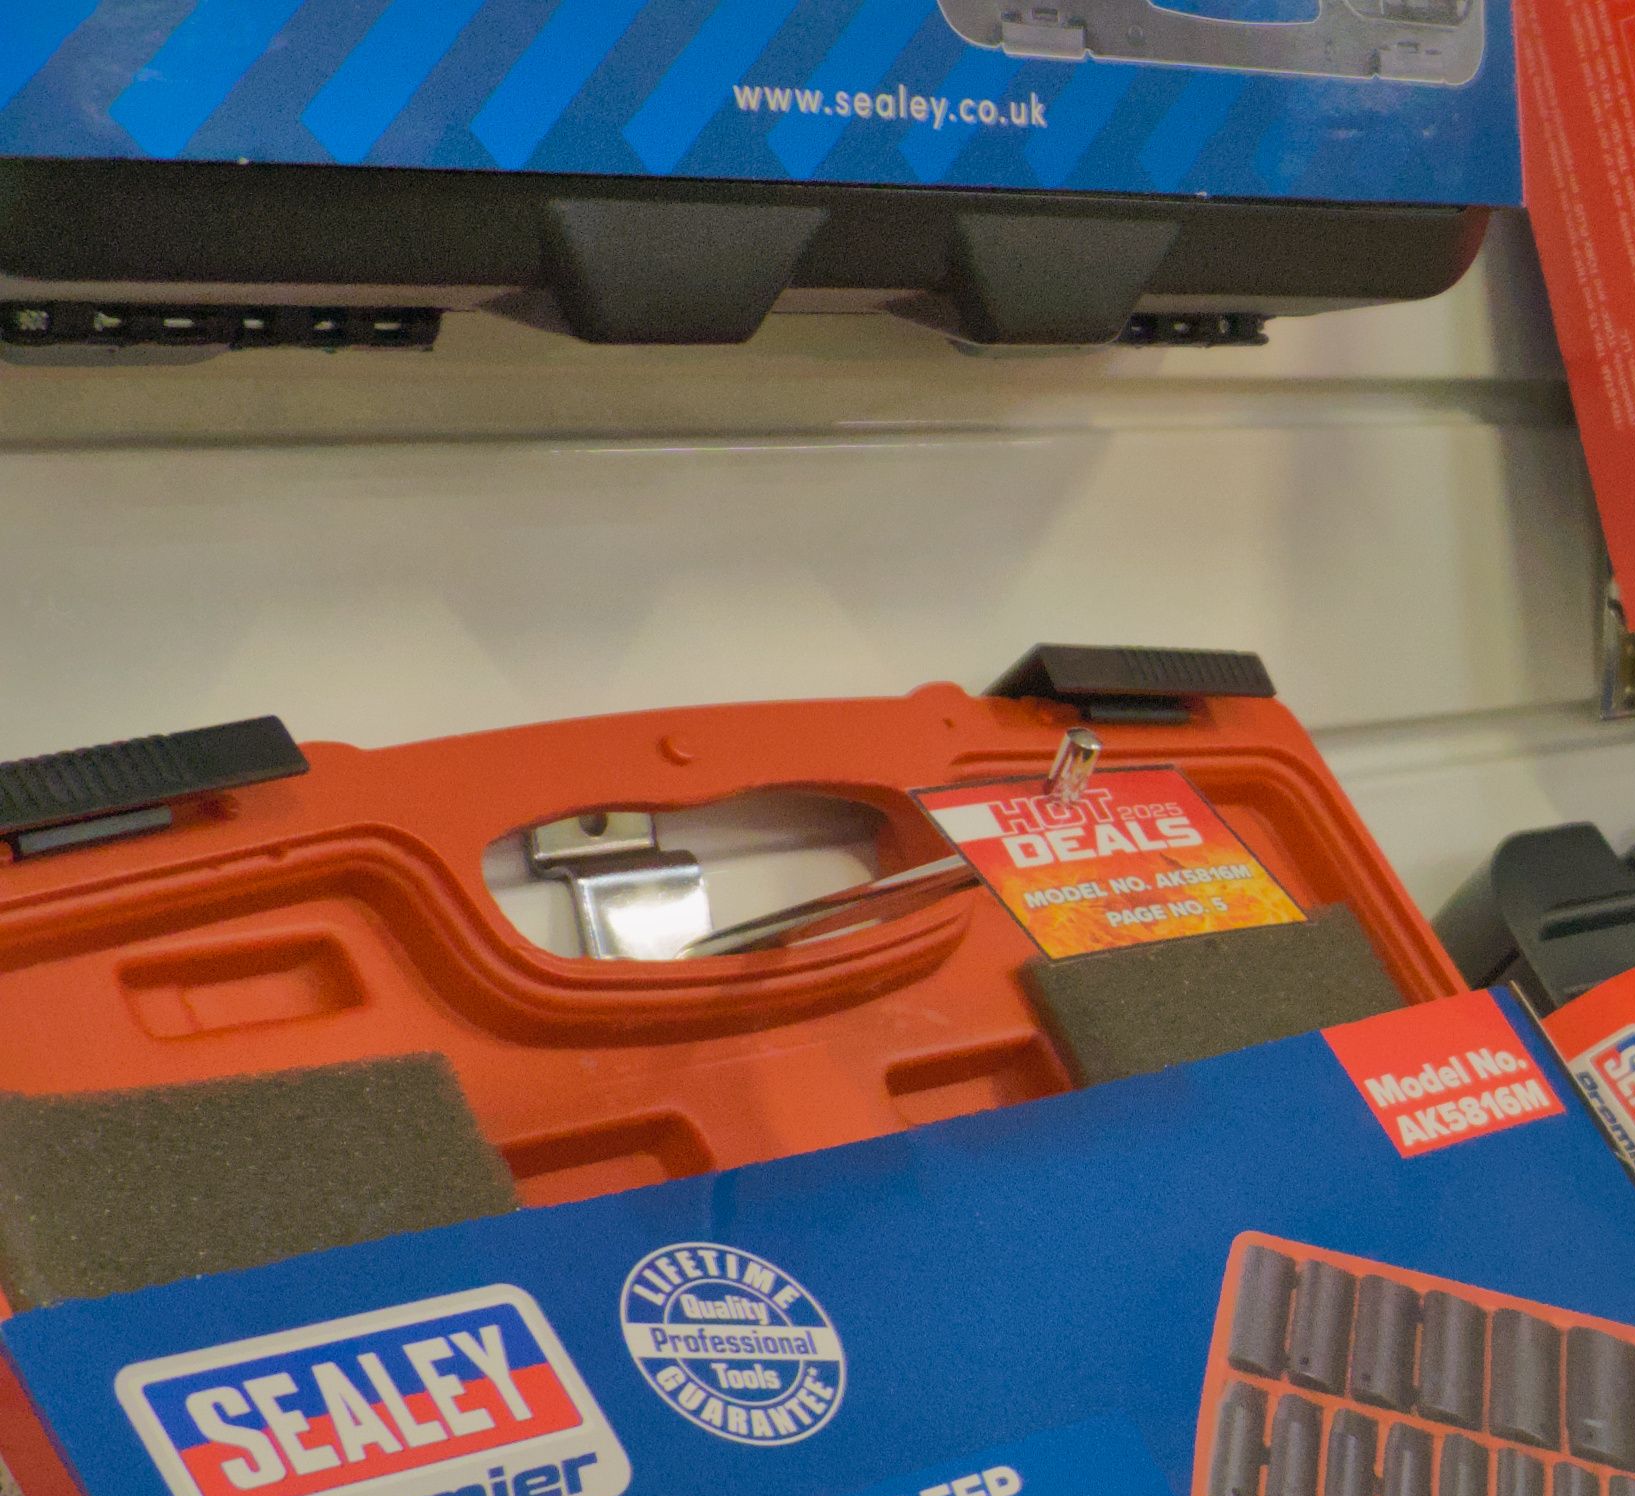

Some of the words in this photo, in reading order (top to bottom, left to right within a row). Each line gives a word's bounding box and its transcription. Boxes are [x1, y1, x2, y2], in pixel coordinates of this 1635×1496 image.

[734, 83, 1048, 130] www.sealey.co.uk
[989, 788, 1114, 835] HOT
[1117, 802, 1185, 821] 2025
[1002, 816, 1203, 868] DEALS
[1023, 881, 1108, 908] MODEL
[1109, 876, 1151, 896] NO.
[1155, 864, 1253, 889] AK5816M
[1105, 901, 1167, 927] PAGE
[1171, 900, 1209, 918] NO.
[1210, 896, 1229, 912] 5
[1363, 1058, 1467, 1110] Model
[1473, 1045, 1529, 1083] No.
[1393, 1081, 1550, 1148] AK5816M
[631, 1249, 801, 1310] LIFETIME
[680, 1293, 772, 1326] Quality
[648, 1326, 819, 1355] Professional
[710, 1362, 783, 1390] Tools
[184, 1322, 536, 1491] SEALEY
